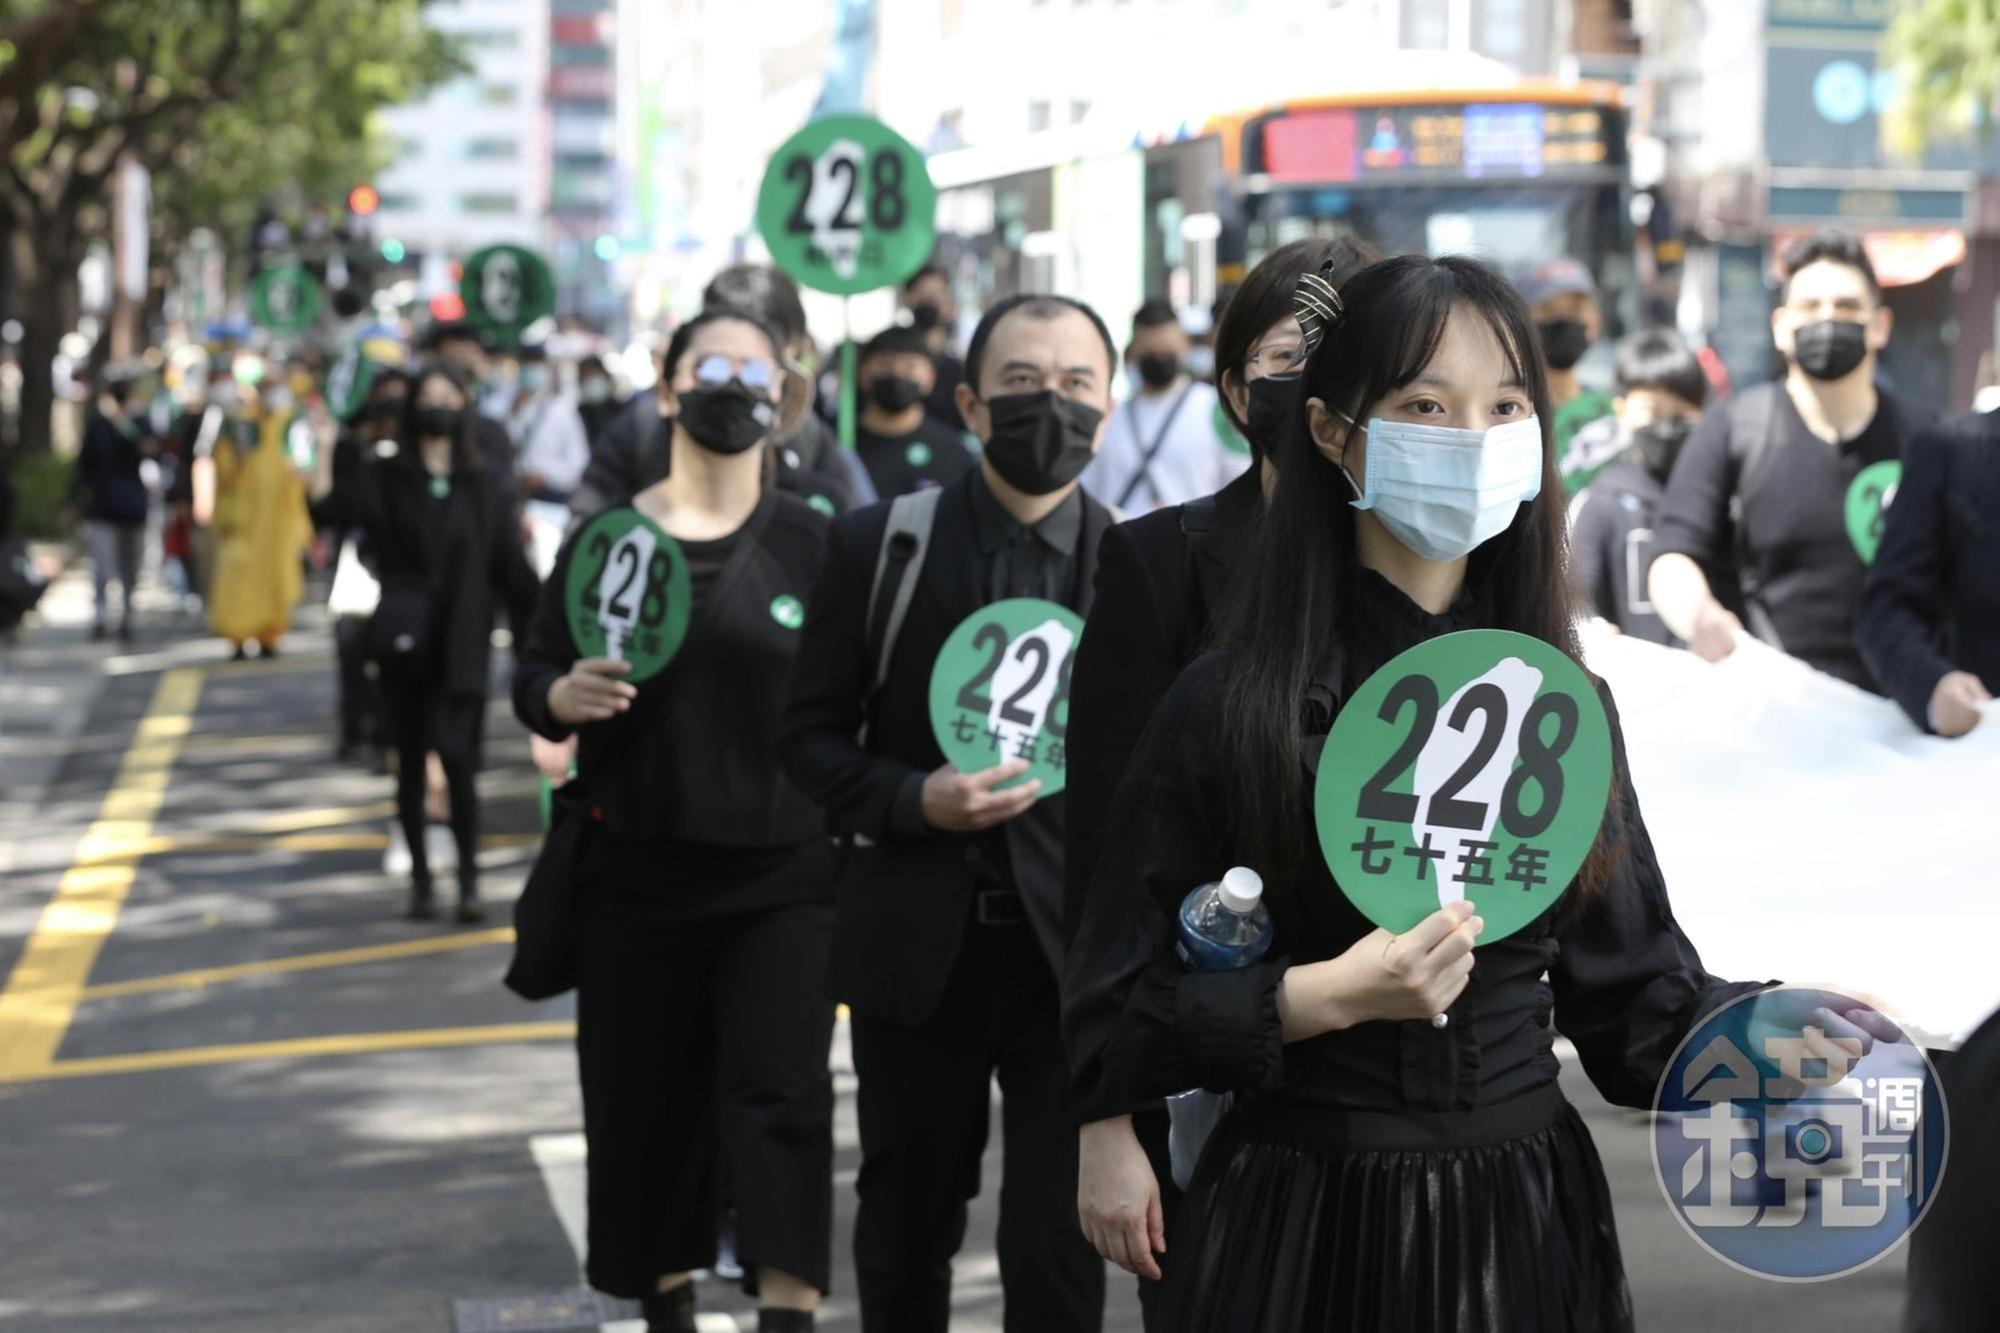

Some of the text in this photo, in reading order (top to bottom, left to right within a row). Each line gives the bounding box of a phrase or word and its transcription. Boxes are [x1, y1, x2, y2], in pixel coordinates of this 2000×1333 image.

[784, 146, 907, 234] 228
[580, 531, 672, 629] 228
[1355, 673, 1580, 839] 228
[1350, 825, 1551, 892] 七十五年
